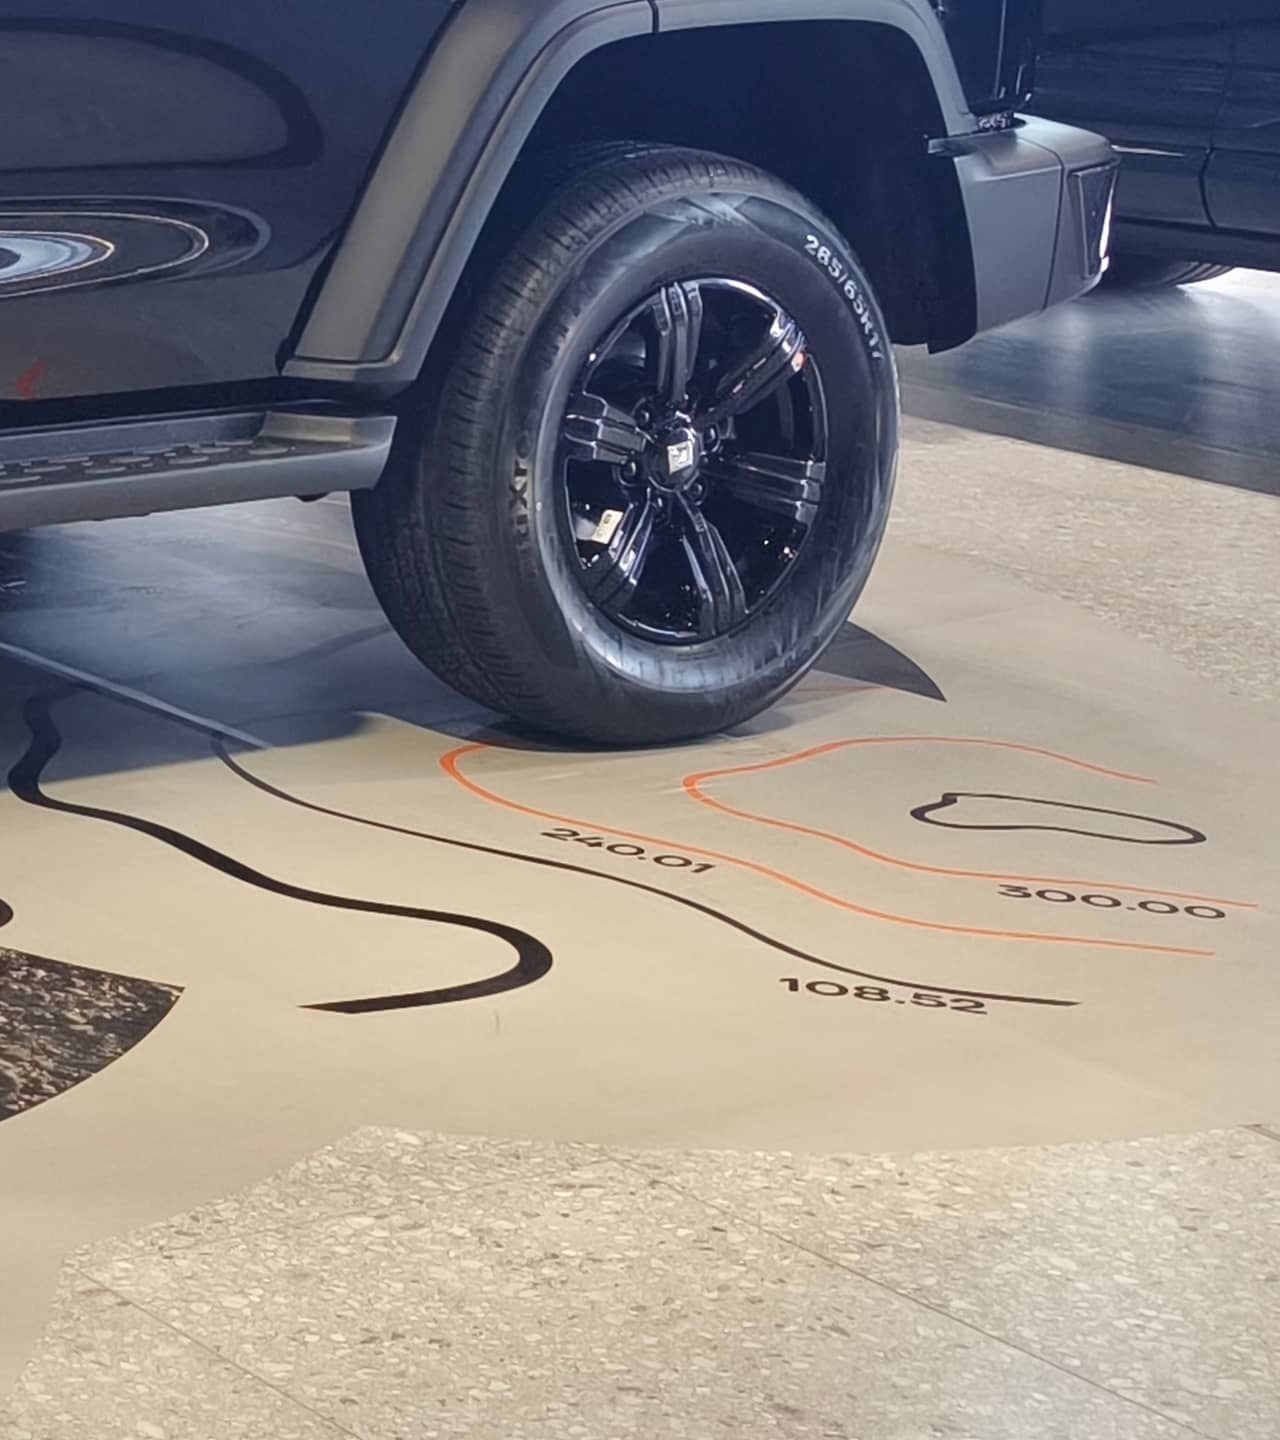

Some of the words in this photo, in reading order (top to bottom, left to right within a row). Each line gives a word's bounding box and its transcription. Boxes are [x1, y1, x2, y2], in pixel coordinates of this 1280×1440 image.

[540, 827, 716, 874] 240.01
[996, 883, 1226, 922] 300.00
[778, 976, 988, 1016] 108.52
